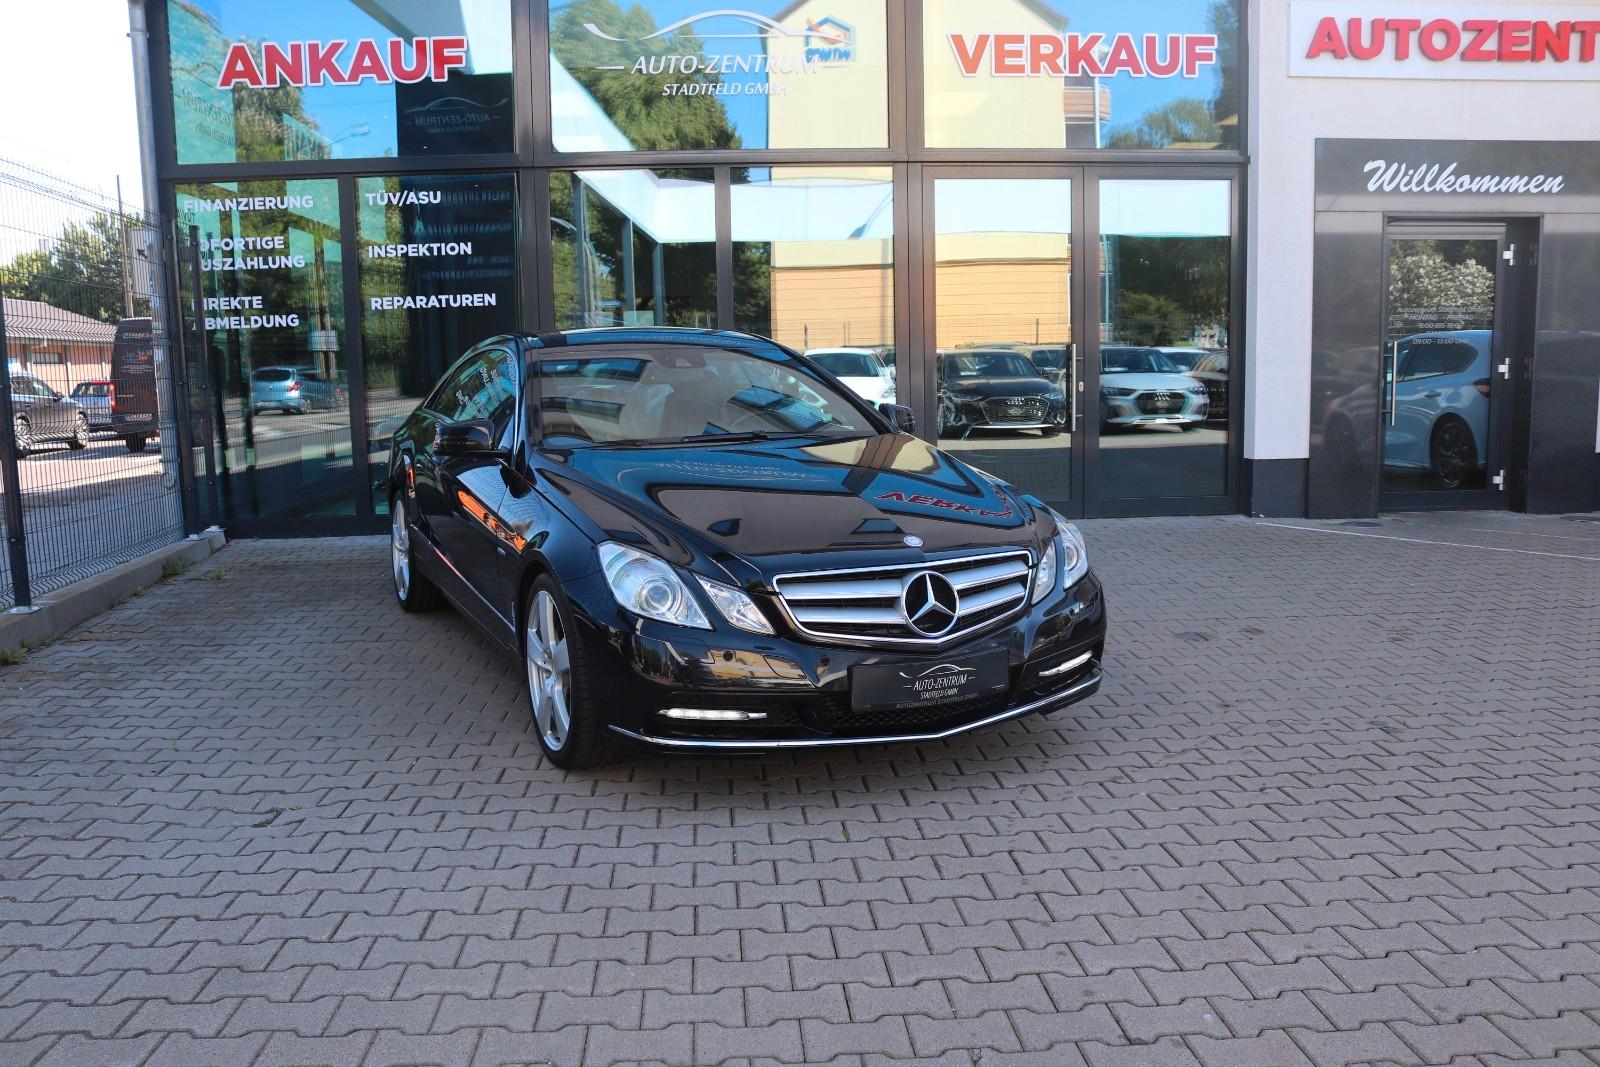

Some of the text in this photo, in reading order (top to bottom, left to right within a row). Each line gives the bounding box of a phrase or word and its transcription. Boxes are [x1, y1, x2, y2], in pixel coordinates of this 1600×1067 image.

[1305, 17, 1600, 62] AUTOZENT
[218, 36, 466, 89] ANKAUF
[948, 32, 1218, 78] VERKAUF
[631, 54, 820, 74] AUTO-ZENTRUM
[662, 83, 742, 96] STADTFELD
[1363, 160, 1565, 194] Willkommen
[183, 195, 315, 213] FINANZIERUNG
[365, 190, 442, 207] TÜV/ASU
[188, 236, 285, 252] OFORTIGE
[368, 242, 472, 258] INSPEKTION
[189, 255, 306, 272] USZAHLUNG
[191, 296, 263, 311] IREKTE
[370, 293, 497, 310] REPARATUREN
[191, 314, 300, 331] BMELDUNG
[913, 674, 968, 691] AUTO-ZENTRUM
